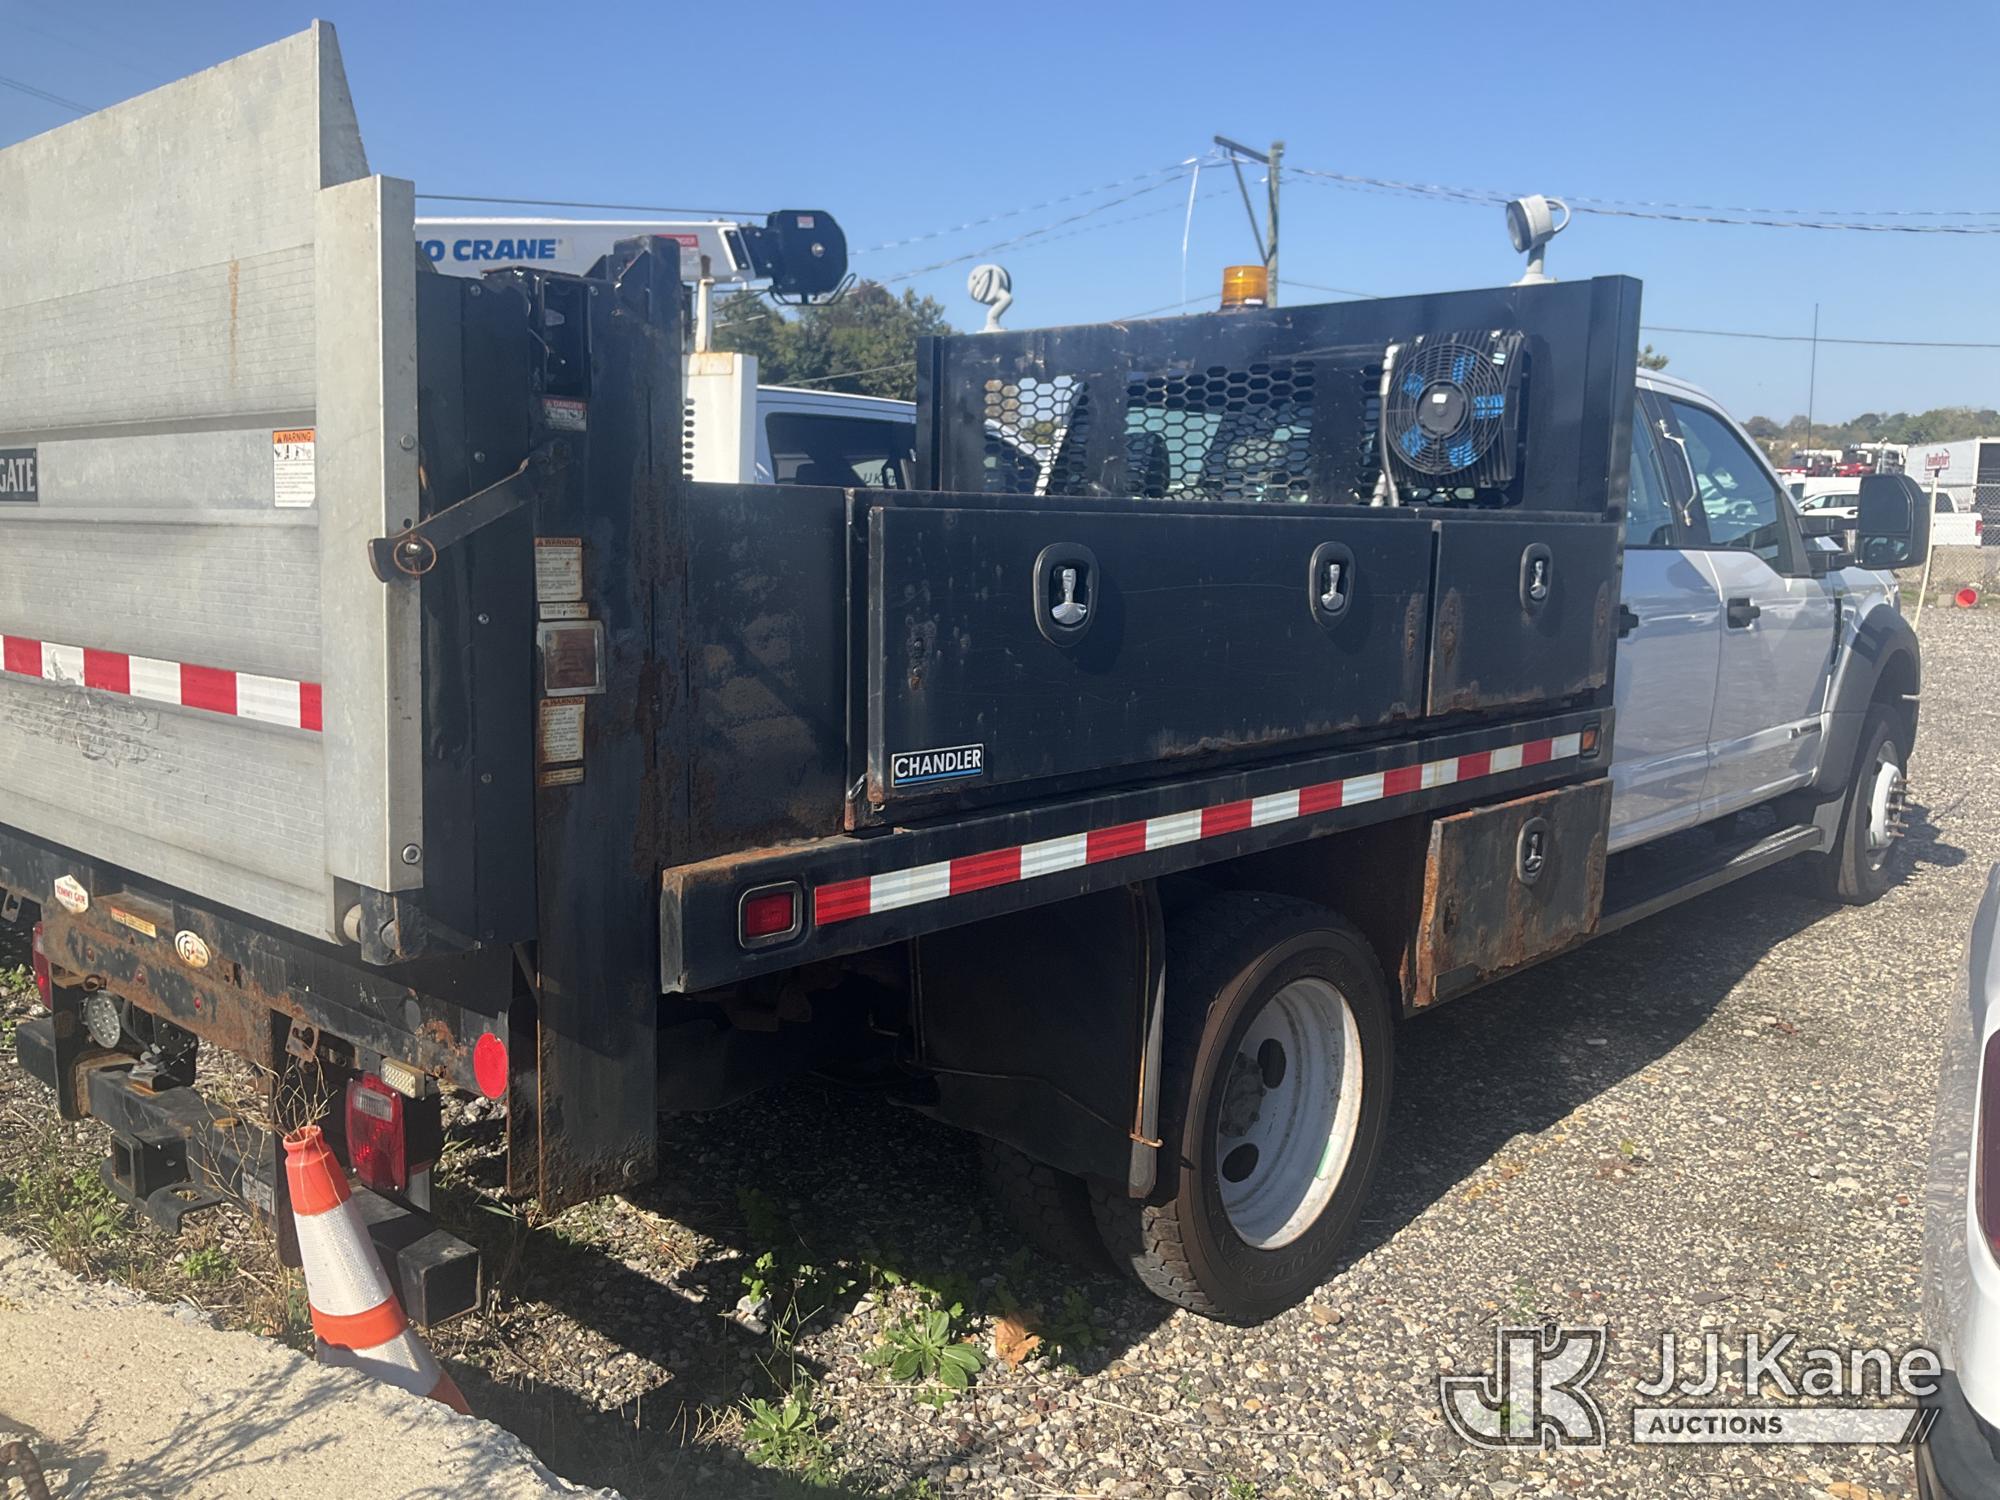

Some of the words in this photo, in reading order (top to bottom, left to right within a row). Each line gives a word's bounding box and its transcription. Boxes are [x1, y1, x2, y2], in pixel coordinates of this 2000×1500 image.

[453, 238, 557, 262] CRANE
[283, 432, 311, 442] WARNING
[895, 749, 981, 778] CHANDLER
